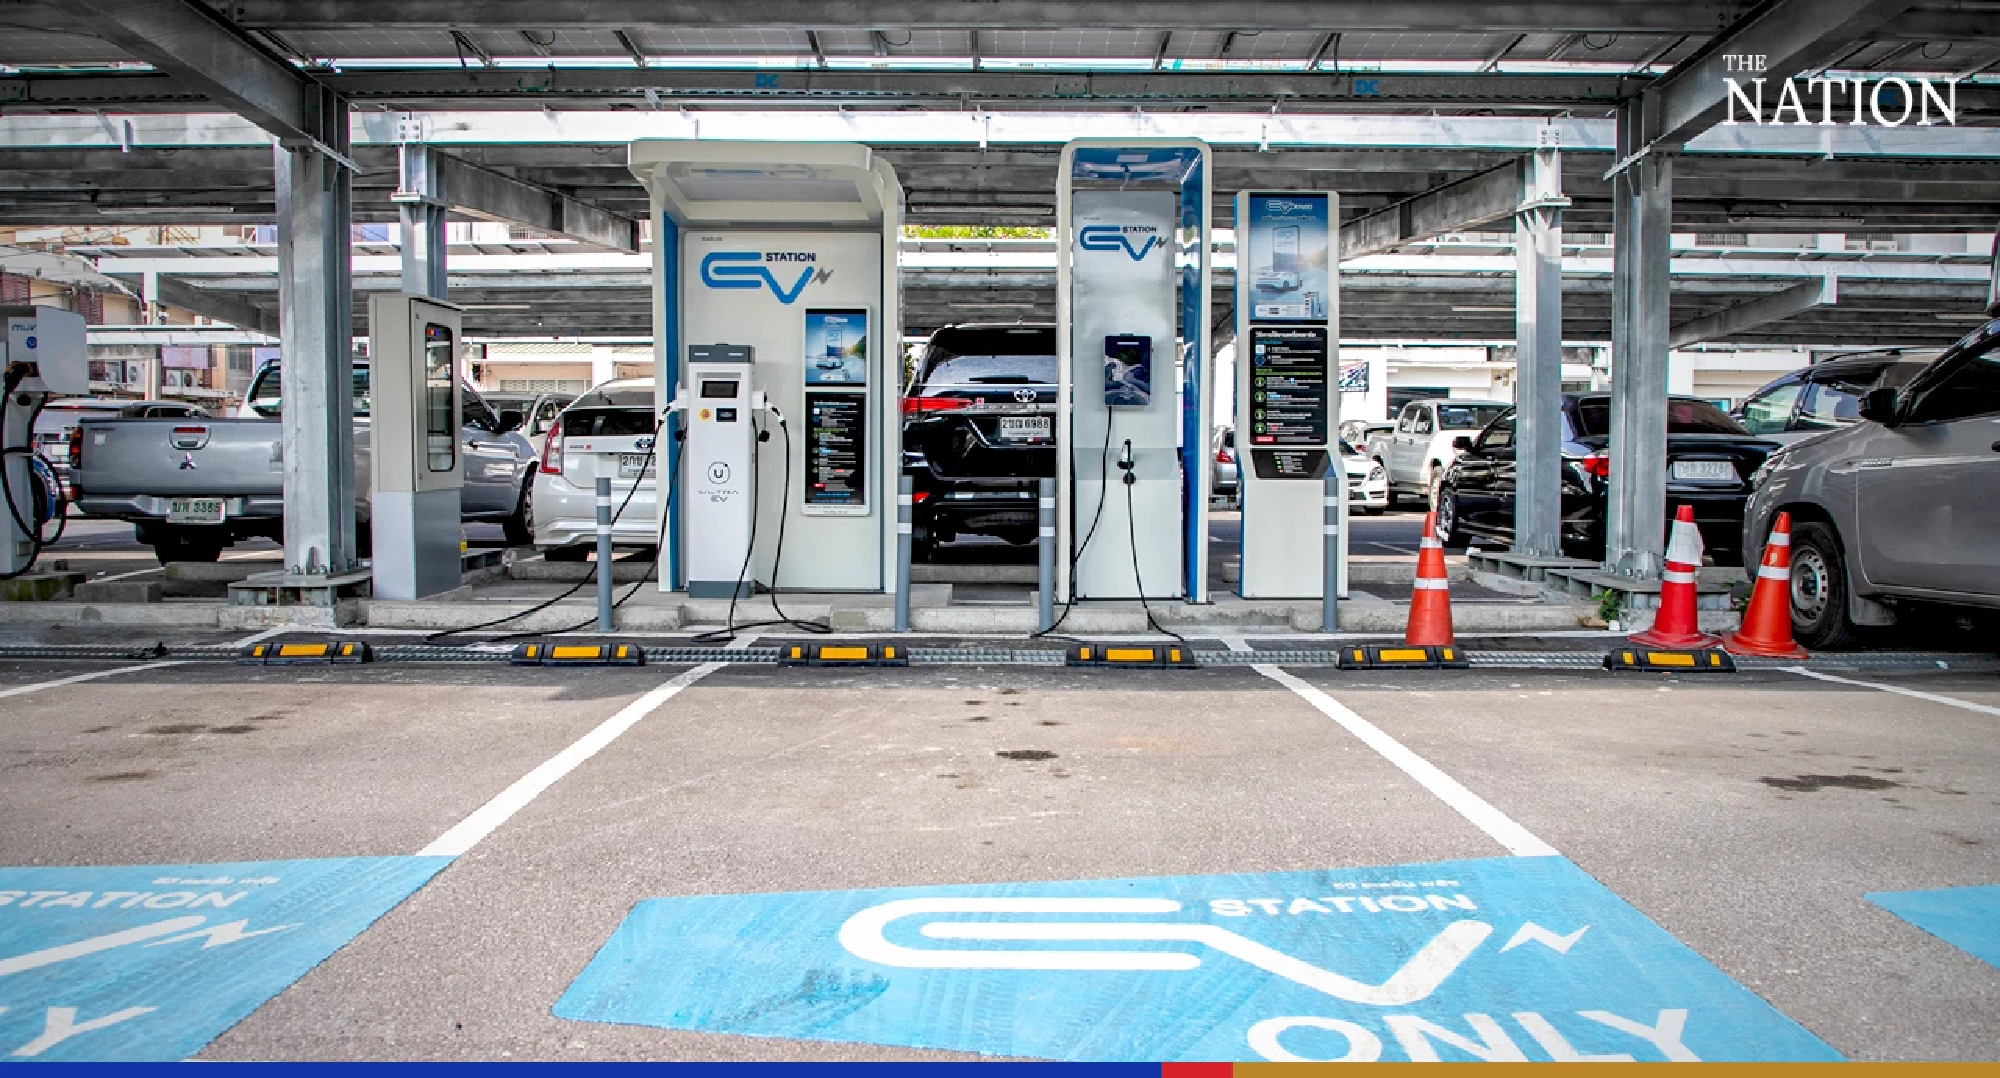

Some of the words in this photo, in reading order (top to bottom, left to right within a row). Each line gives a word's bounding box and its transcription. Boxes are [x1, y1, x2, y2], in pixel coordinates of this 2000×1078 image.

[1080, 226, 1157, 261] EV
[1122, 226, 1157, 234] STATION
[765, 252, 817, 262] STATION
[701, 251, 815, 304] EV
[1210, 893, 1479, 916] STATION
[838, 897, 1494, 1006] EV
[1246, 1008, 1702, 1061] ONLY
